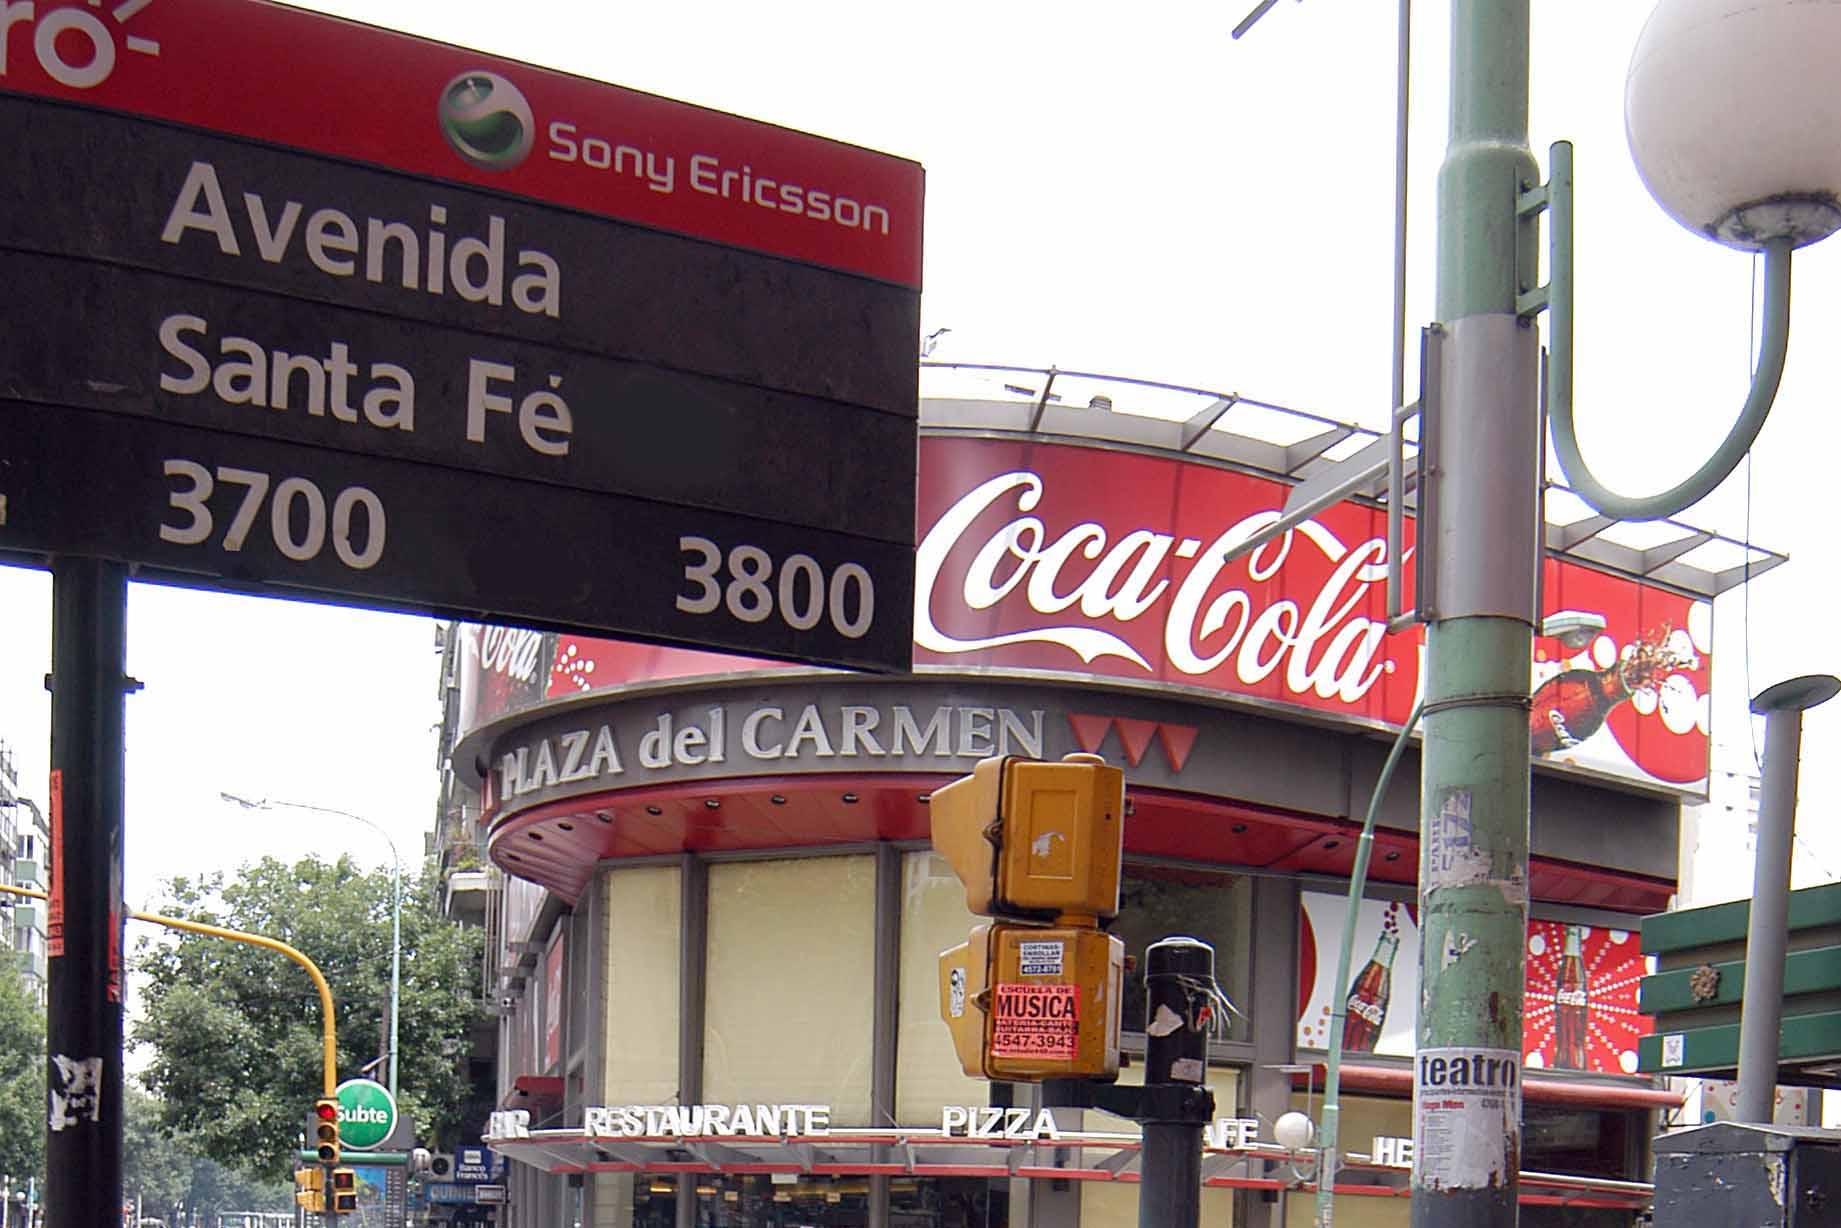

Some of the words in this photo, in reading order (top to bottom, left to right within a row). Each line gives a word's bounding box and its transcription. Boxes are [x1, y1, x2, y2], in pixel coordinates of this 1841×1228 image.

[549, 121, 674, 193] Sony
[690, 154, 889, 235] Ericsson
[161, 161, 561, 318] Avenida
[159, 314, 414, 431] Santa
[466, 358, 574, 456] Fé
[160, 460, 386, 569] 3700
[675, 536, 875, 638] 3800
[912, 470, 1412, 703] Coca-Cola
[500, 724, 624, 800] PLAZA
[639, 707, 725, 768] del
[742, 703, 1046, 759] CARMEN
[996, 995, 1076, 1018] MUSICA
[1000, 986, 1053, 994] ESCUELA
[996, 1035, 1075, 1048] 4547-3943
[1421, 1054, 1516, 1088] teatro
[336, 1104, 388, 1124] Subte
[583, 1104, 832, 1138] RESTAURANTE
[942, 1106, 1060, 1140] PIZZA
